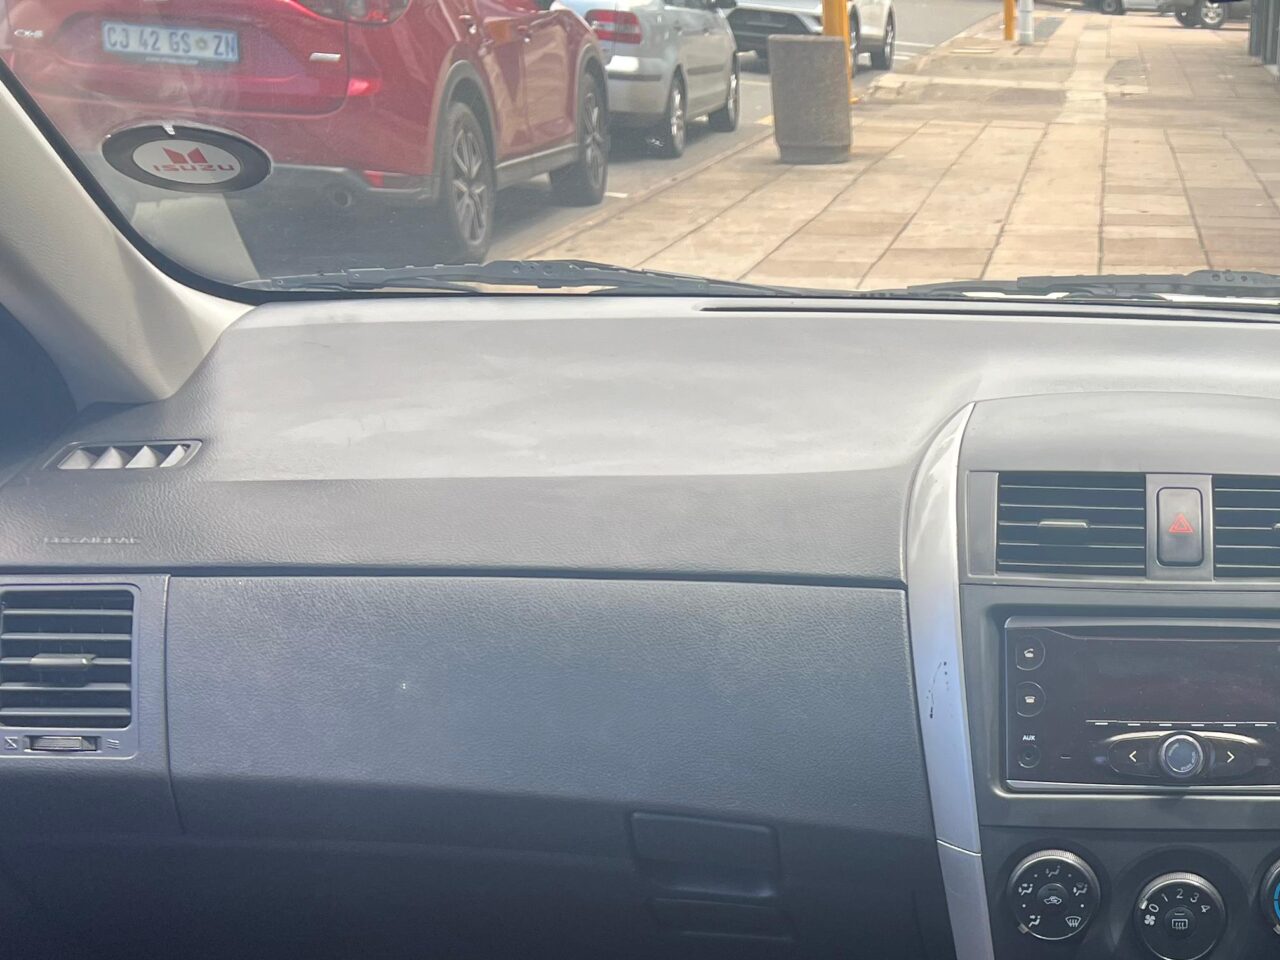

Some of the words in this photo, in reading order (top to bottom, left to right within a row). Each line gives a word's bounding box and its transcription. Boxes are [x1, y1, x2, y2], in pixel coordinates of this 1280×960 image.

[107, 27, 130, 49] CJ
[138, 31, 161, 51] 42
[169, 32, 191, 53] GS
[213, 35, 236, 57] ZN
[152, 164, 235, 172] ISUZU
[1148, 903, 1159, 912] 0
[1161, 893, 1168, 902] 1
[1176, 888, 1184, 899] 2
[1190, 892, 1200, 903] 3
[1201, 904, 1211, 913] 4
